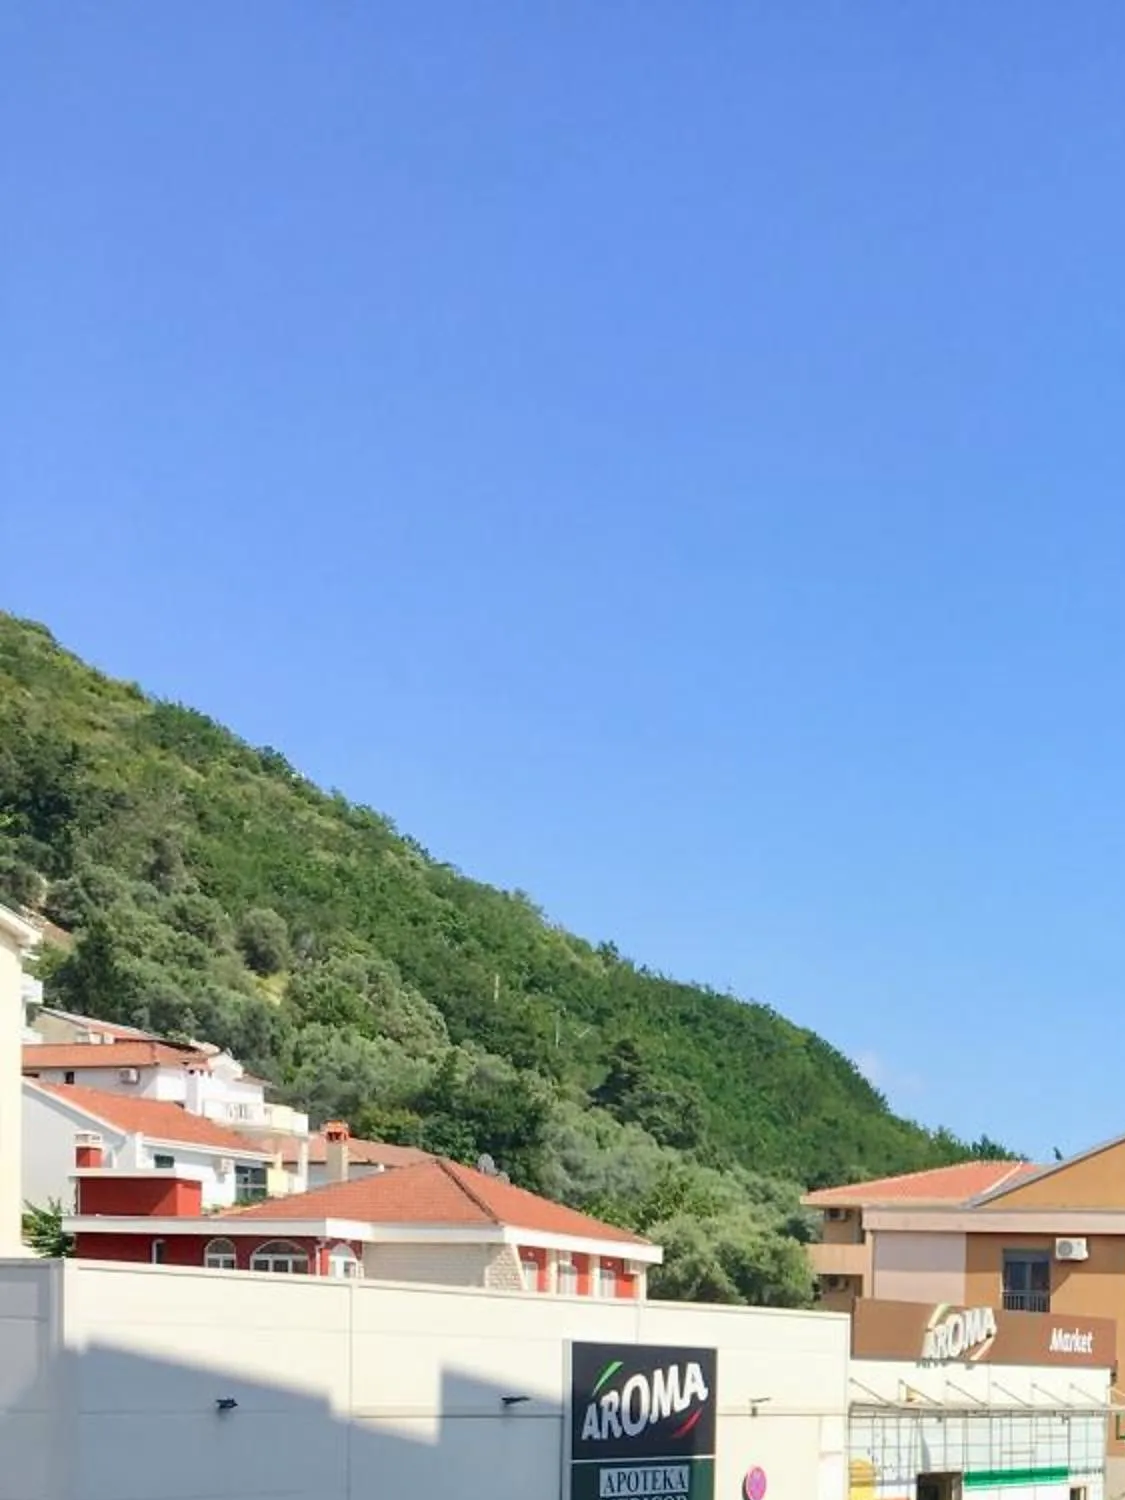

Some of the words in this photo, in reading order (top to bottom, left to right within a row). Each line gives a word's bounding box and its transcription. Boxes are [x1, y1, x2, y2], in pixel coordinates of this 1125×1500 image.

[922, 1307, 997, 1358] AROMA
[1049, 1327, 1093, 1354] Market
[582, 1362, 708, 1440] AROMA
[604, 1469, 687, 1493] APOTEKA
